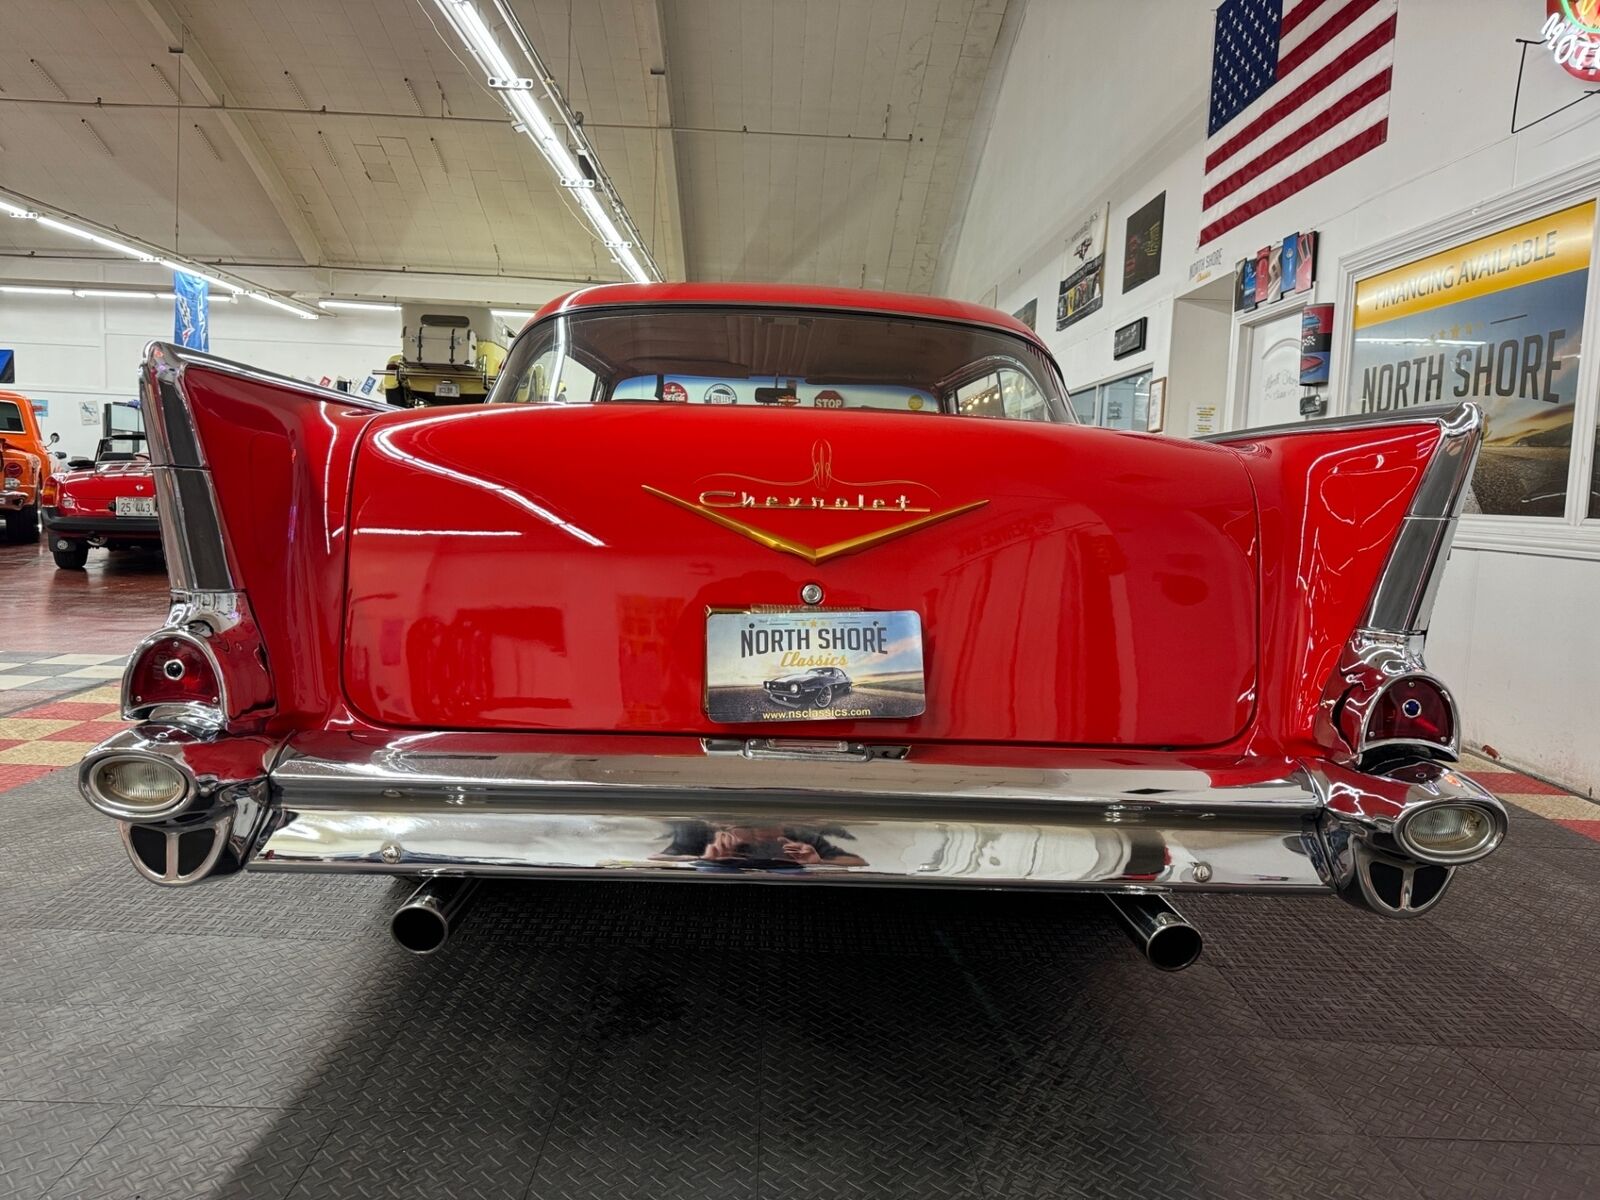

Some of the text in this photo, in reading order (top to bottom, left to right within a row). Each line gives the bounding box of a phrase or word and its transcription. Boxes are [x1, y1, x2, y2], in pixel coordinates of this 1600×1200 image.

[1375, 232, 1557, 310] FINANCING AVAILABLE
[1362, 353, 1444, 412] NORTH
[1453, 329, 1564, 403] SHORE
[815, 399, 842, 407] STOP
[121, 503, 151, 512] 25 443
[699, 491, 911, 511] Chevrolet
[741, 627, 888, 657] NORTH SHORE
[780, 652, 848, 667] Classics
[762, 708, 871, 720] www.nsclassics.com
